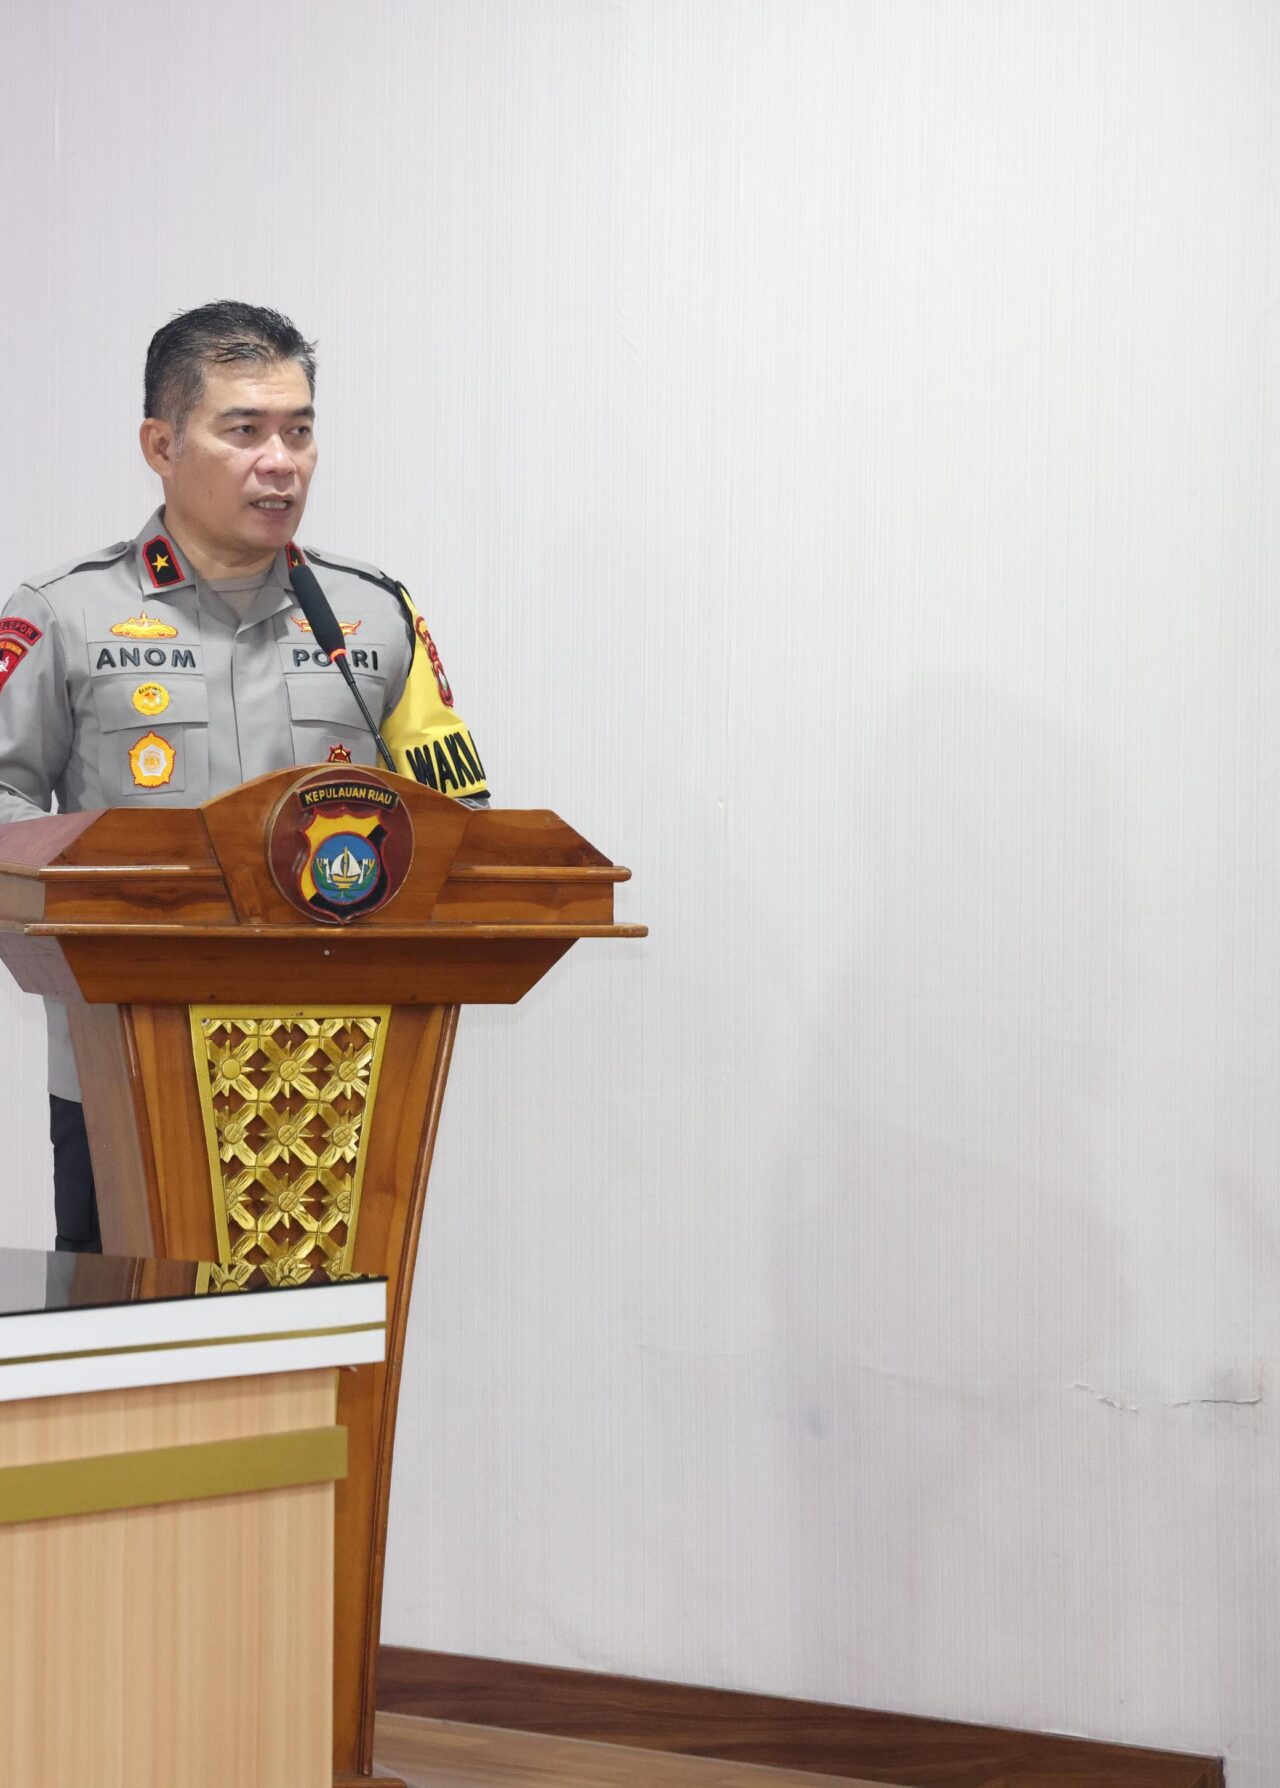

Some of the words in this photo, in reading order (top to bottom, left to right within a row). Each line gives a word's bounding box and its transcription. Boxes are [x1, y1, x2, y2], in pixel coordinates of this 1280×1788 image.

[96, 647, 197, 670] ANOM
[293, 649, 379, 671] PORI
[304, 787, 366, 805] KEPULAUAN
[367, 790, 393, 805] RIAU
